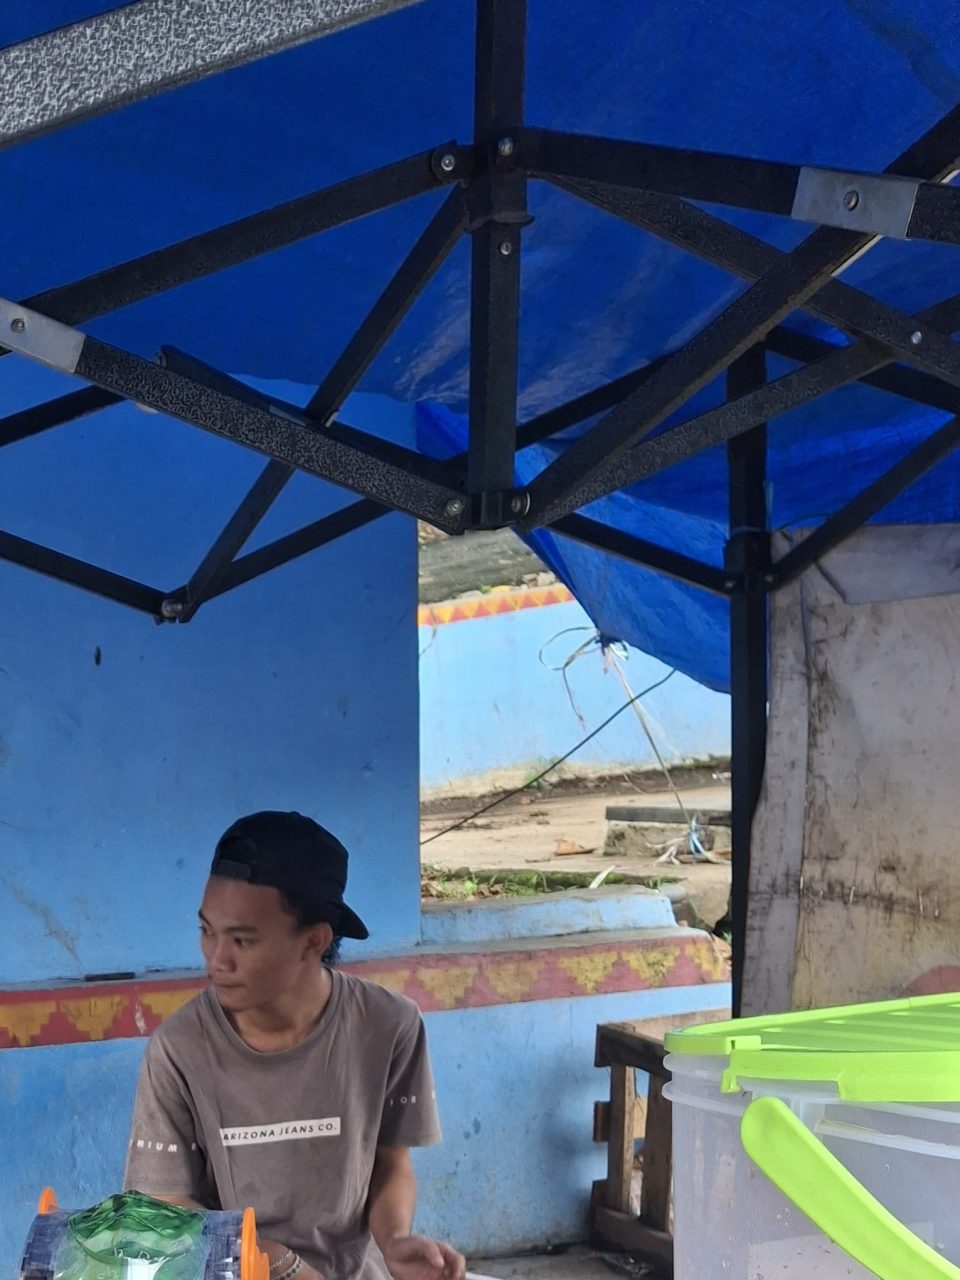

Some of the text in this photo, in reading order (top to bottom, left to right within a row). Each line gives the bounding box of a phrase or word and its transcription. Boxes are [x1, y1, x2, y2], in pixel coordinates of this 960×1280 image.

[223, 1122, 337, 1141] ARIZONA JEANS CO.
